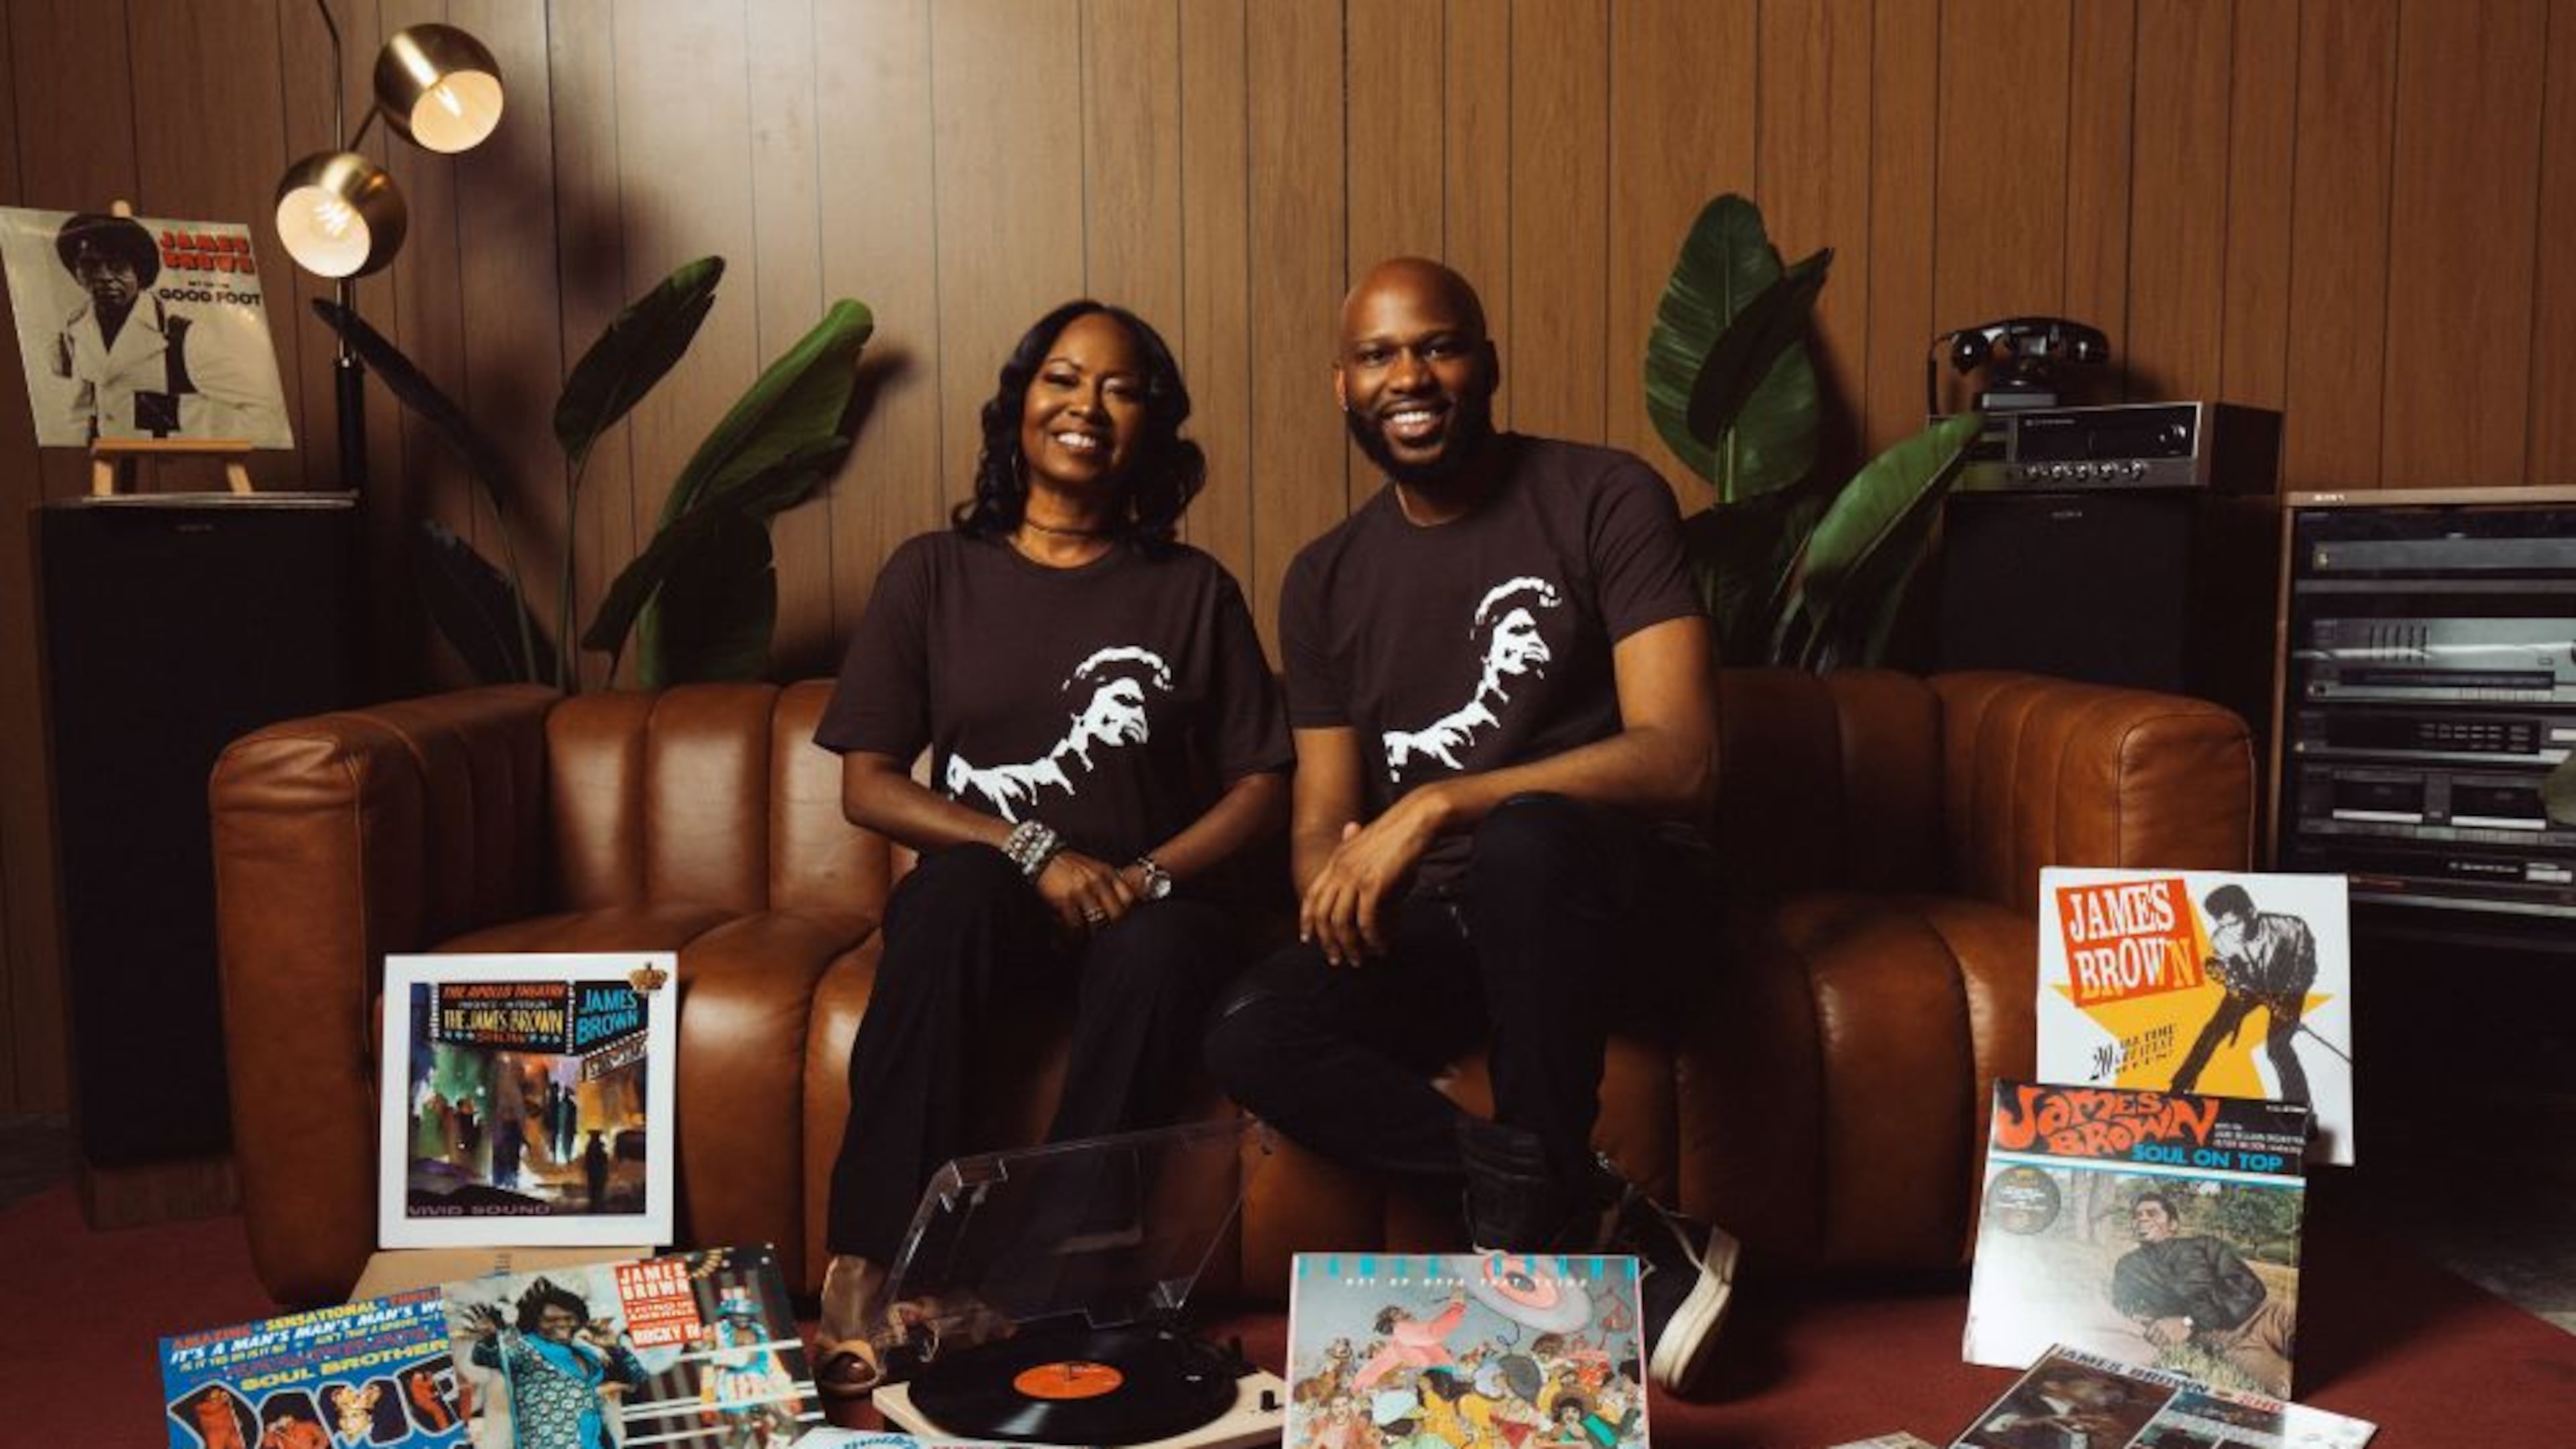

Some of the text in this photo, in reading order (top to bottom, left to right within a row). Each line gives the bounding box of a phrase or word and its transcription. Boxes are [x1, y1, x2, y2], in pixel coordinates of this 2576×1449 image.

[160, 288, 260, 306] GOOD FOOT
[2070, 881, 2175, 944] JAMES
[2074, 937, 2197, 998] BROWN
[579, 989, 638, 1014] JAMES
[444, 1009, 564, 1035] THE JAMES BROWN
[576, 1009, 640, 1046] BROWN
[1998, 1086, 2166, 1150] JAMES
[2049, 1097, 2219, 1157] BROWN
[2132, 1143, 2284, 1172] SOUL ON TOP
[409, 1205, 551, 1216] VIVID SOUND
[620, 1262, 686, 1286] JAMES
[621, 1277, 690, 1301] BROWN
[266, 1300, 376, 1332] SENSATIONAL
[170, 1344, 205, 1364] IT'S
[211, 1342, 226, 1356] A
[231, 1330, 290, 1352] MAN'S
[294, 1318, 351, 1340] MAN'S
[357, 1305, 413, 1327] MAN'S
[633, 1323, 681, 1345] ROCKY
[241, 1367, 315, 1392] SOUL
[321, 1339, 449, 1376] BROTHER
[2060, 1347, 2123, 1373] JAMES
[2131, 1369, 2210, 1394] BROWN
